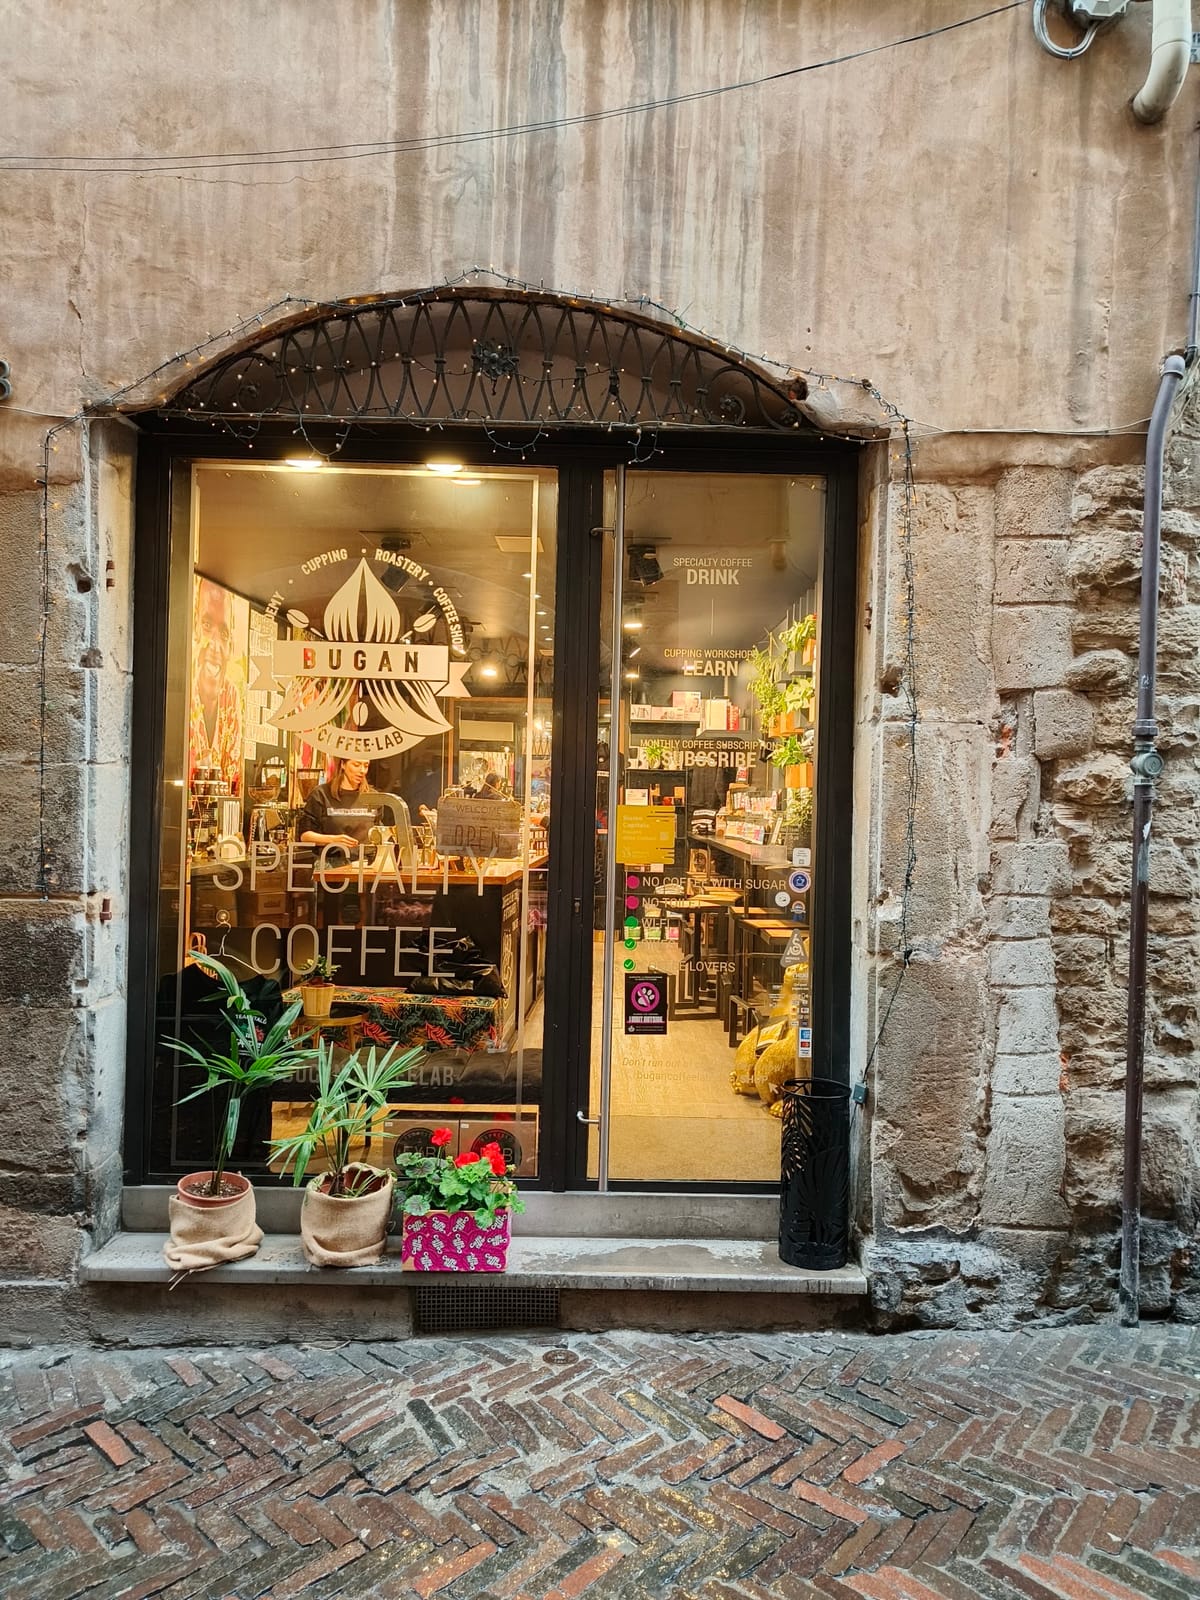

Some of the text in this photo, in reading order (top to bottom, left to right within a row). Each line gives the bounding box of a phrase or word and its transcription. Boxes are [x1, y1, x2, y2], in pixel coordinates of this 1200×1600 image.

[301, 548, 348, 575] CUPPING
[374, 548, 430, 582] ROASTERY
[673, 557, 752, 568] SPECIALTY COFFEE
[686, 569, 740, 585] DRINK
[303, 648, 419, 673] BUGAN
[664, 649, 758, 659] CUPPING WORKSHOP
[684, 660, 739, 677] LEARN
[640, 739, 778, 751] MONTHLY COFFEE SUBSCRIPON
[661, 750, 757, 768] SUBSCRIBE
[455, 824, 500, 852] OPEN
[212, 838, 499, 897] SPECIALTY
[642, 876, 660, 887] NO
[709, 878, 742, 889] WITH
[745, 879, 787, 890] SUGAR
[642, 897, 660, 907] NO
[641, 918, 670, 929] WI-FI
[250, 922, 457, 978] COFFEE
[690, 961, 736, 973] LOVERS
